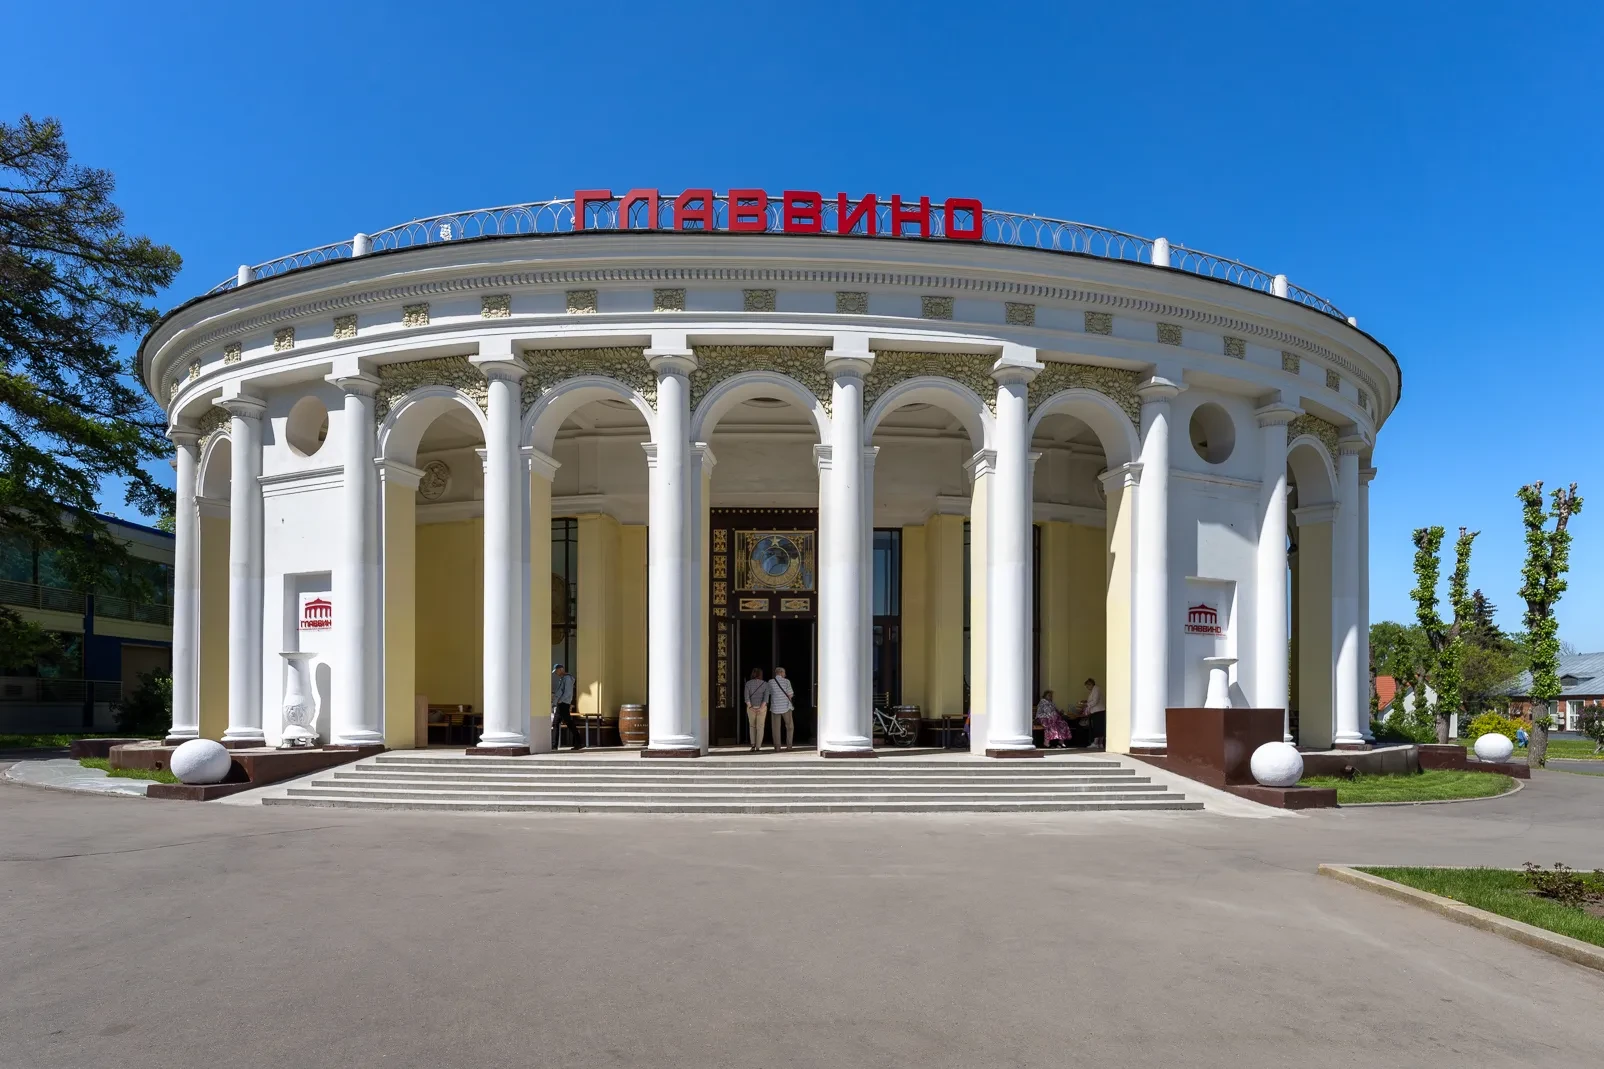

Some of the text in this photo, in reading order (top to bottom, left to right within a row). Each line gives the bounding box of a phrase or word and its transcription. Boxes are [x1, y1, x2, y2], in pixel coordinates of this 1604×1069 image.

[574, 189, 983, 239] ГЛАВВИНО
[301, 619, 332, 628] ГЛАВВИН
[1185, 624, 1222, 633] ГЛАВВИНО
